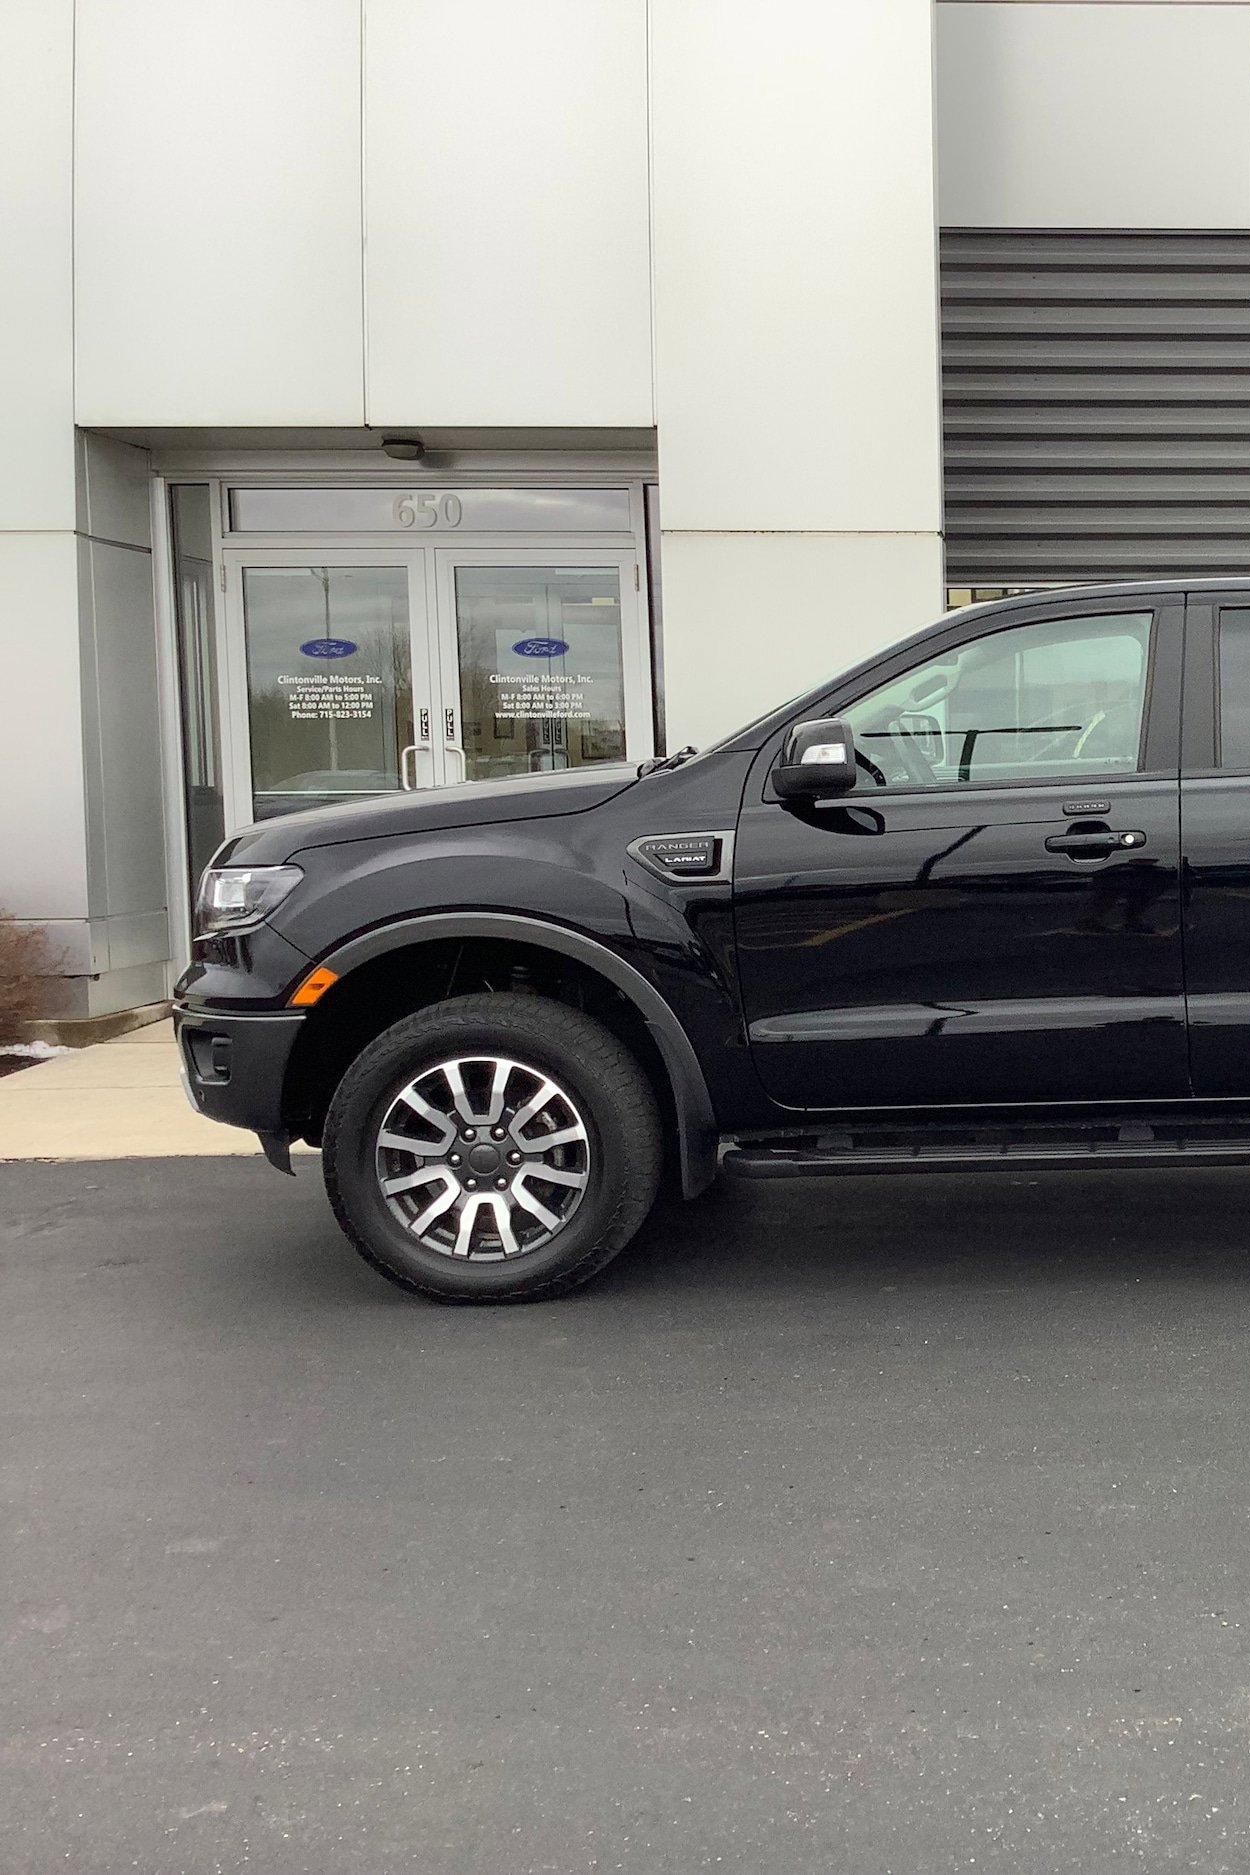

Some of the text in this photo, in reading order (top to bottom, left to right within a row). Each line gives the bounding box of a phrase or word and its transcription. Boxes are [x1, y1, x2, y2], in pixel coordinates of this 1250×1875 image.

[393, 493, 462, 528] 650
[278, 675, 382, 684] Clintonville Motors, Inc.
[489, 674, 594, 684] Clintonville Motors, Inc.
[296, 685, 364, 693] Service/Parts Hours
[501, 693, 584, 701] M-F 8:00 AM to 6:00 PM
[289, 702, 374, 710] Sat 8:00 AM to 12:00 PM
[291, 711, 372, 719] Phone: 715-823-3154
[495, 710, 590, 718] www.clintonvilleford.com
[446, 709, 454, 736] PULL
[646, 842, 709, 851] RANGER
[665, 855, 706, 863] LARIAT
